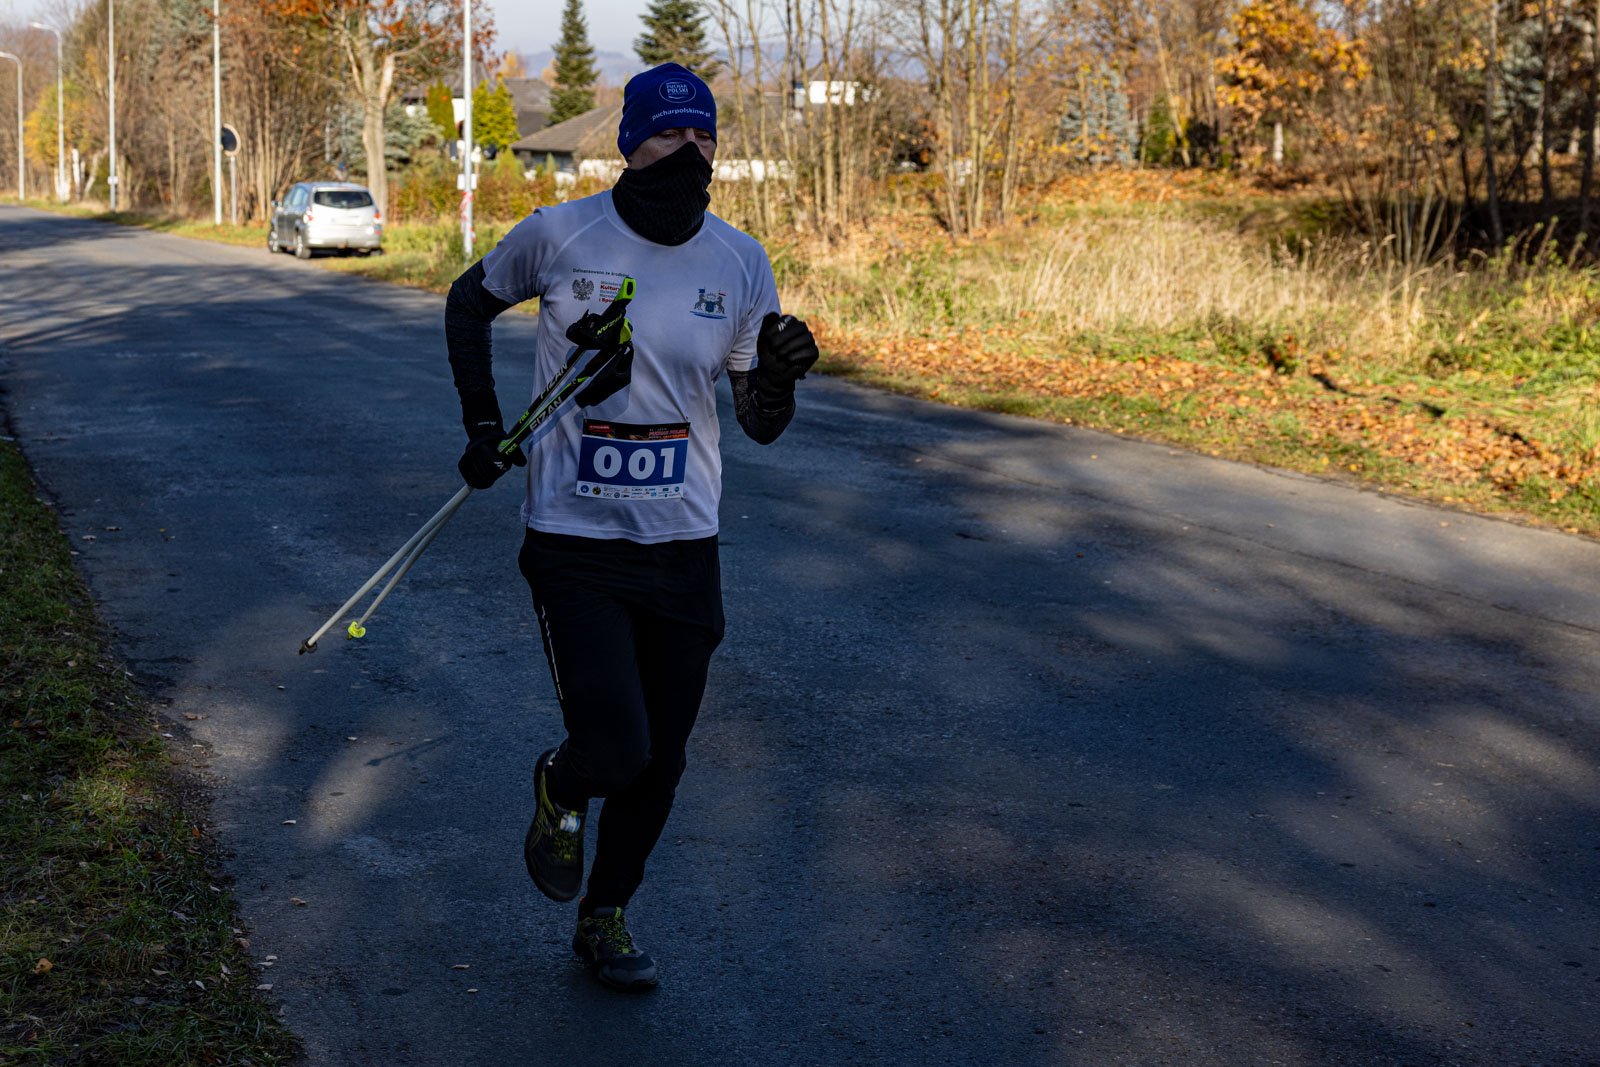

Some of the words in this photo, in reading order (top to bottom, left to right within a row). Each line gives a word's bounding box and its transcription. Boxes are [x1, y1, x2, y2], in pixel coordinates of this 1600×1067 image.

[652, 107, 711, 121] pucharpolskinw.pl
[529, 396, 563, 432] FIZAN
[593, 445, 676, 480] 001
